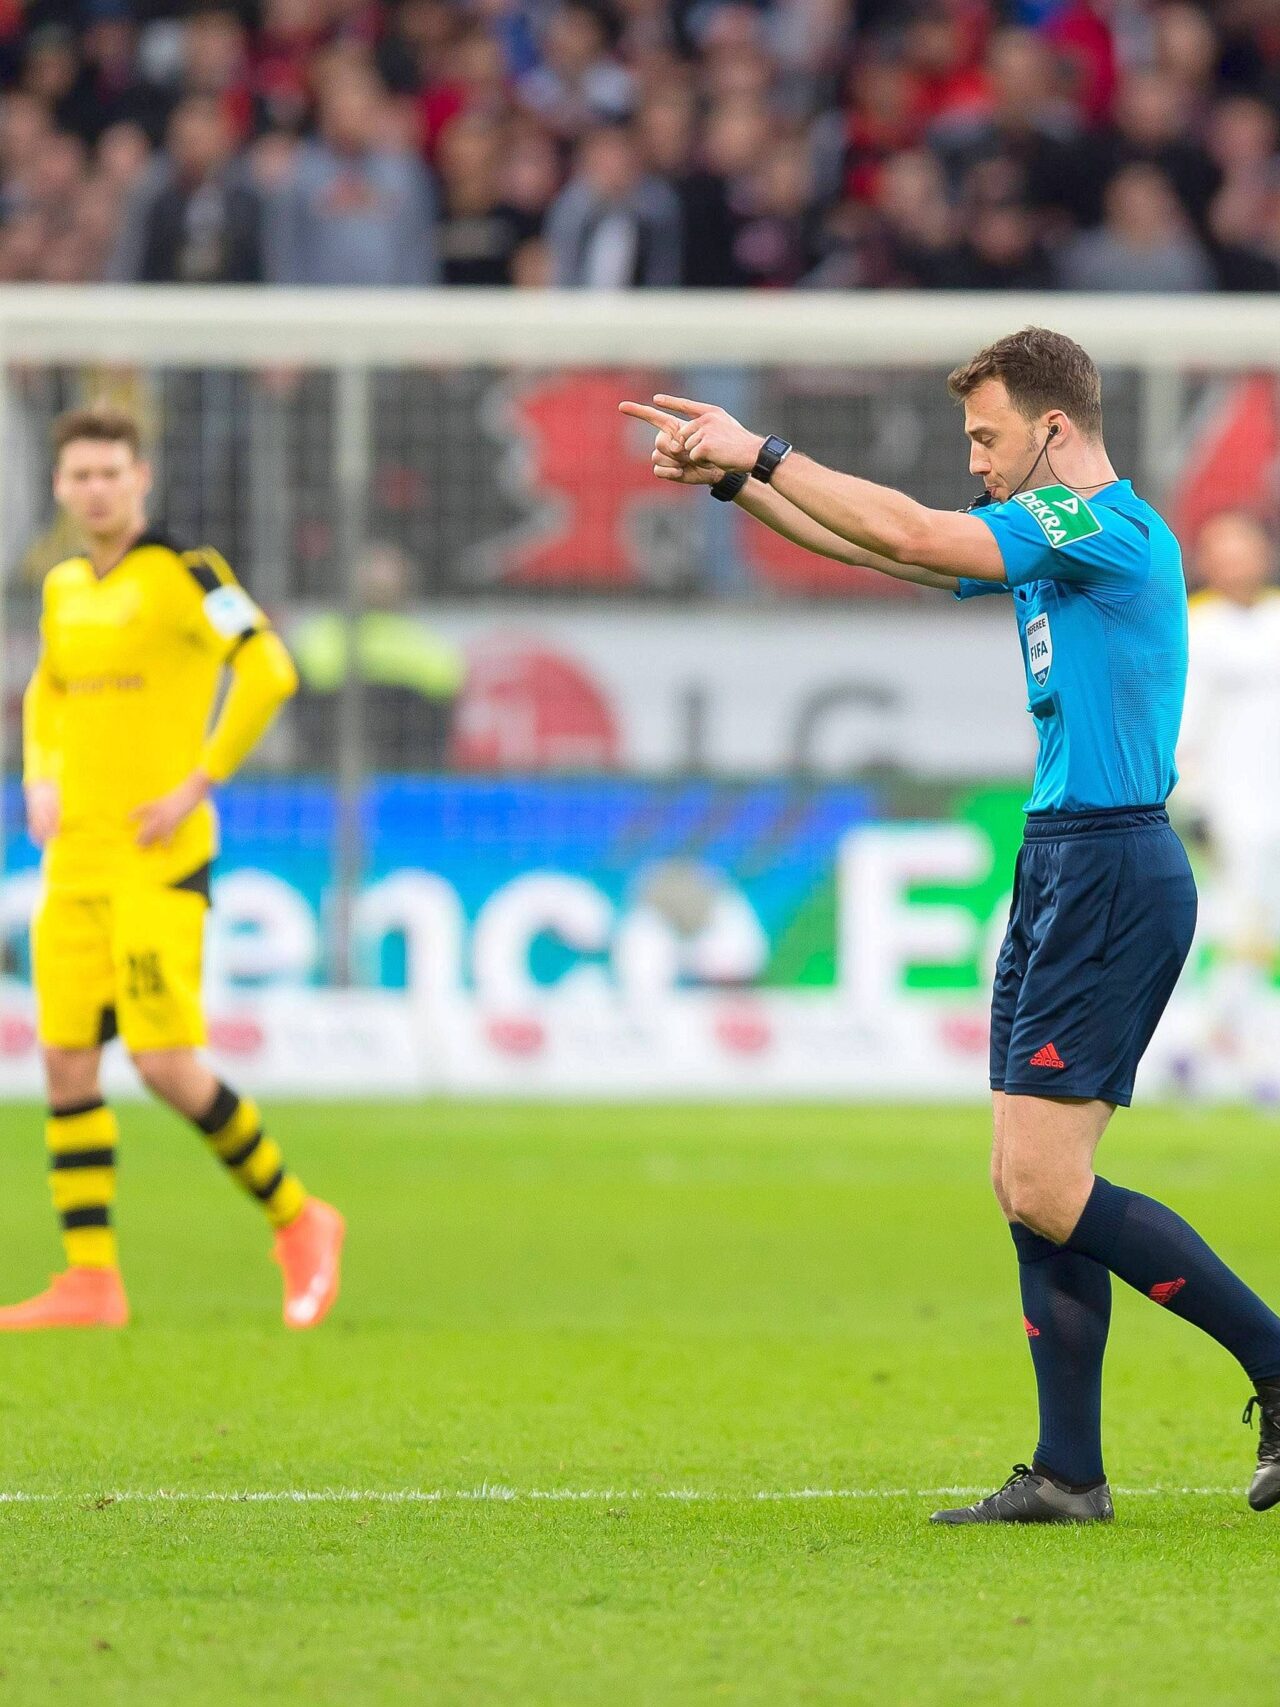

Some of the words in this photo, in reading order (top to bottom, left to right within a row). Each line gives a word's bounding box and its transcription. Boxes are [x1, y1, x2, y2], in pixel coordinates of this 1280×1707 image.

[1016, 492, 1067, 544] DEKRA
[1027, 618, 1047, 636] REFEREE
[1030, 640, 1049, 662] FIFA
[1029, 1057, 1065, 1069] adidas
